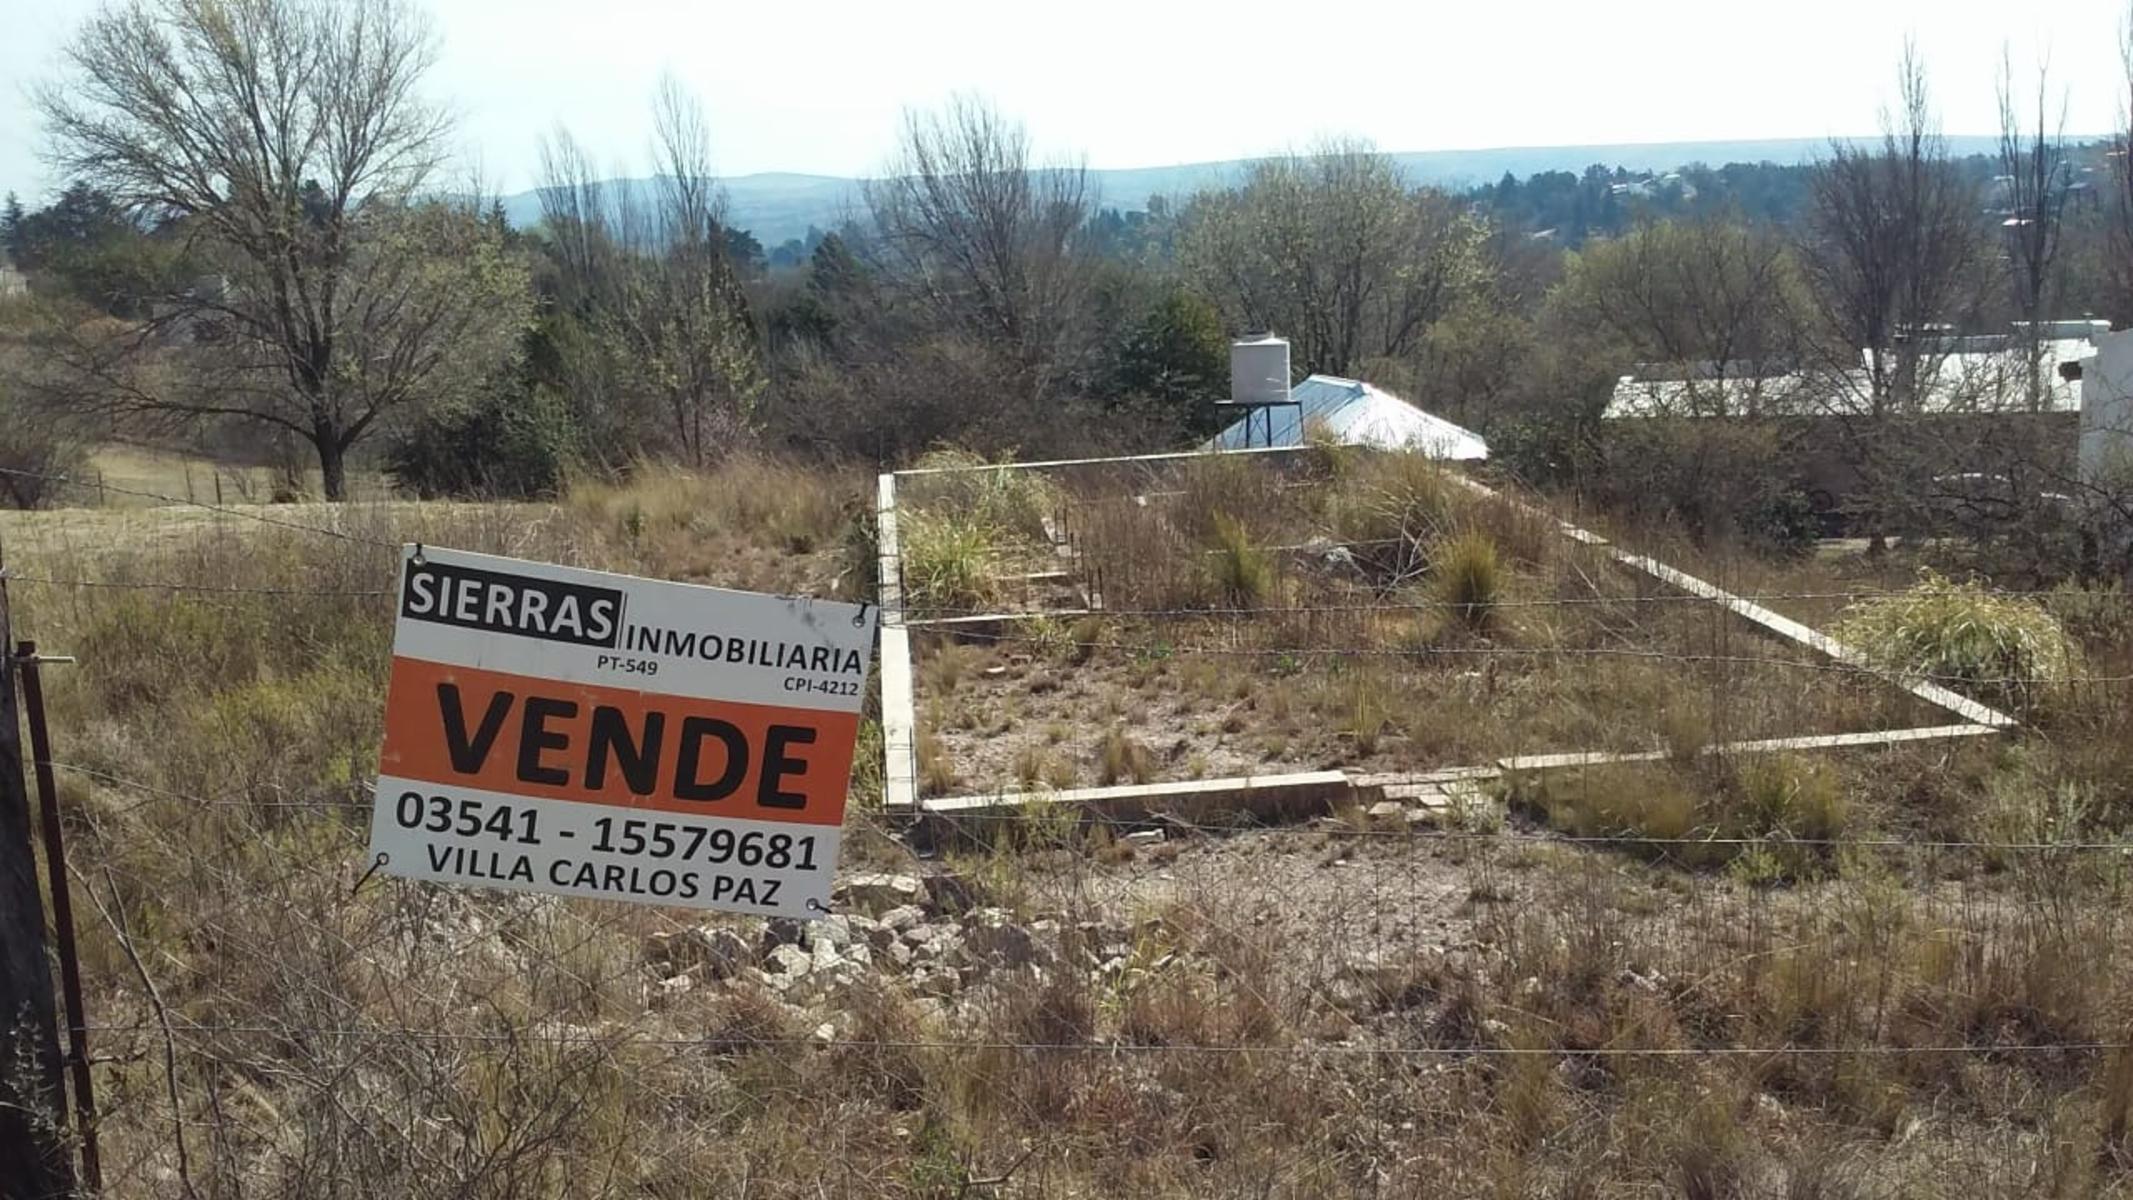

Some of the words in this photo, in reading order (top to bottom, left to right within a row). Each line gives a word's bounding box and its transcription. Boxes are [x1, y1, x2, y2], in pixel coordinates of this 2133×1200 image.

[408, 572, 615, 640] SIERRAS
[625, 624, 863, 676] INMOBILIARIA
[597, 656, 659, 676] PT-549
[783, 676, 859, 697] CPI-4212
[436, 682, 817, 810] VENDE
[396, 791, 542, 845] 03541
[591, 817, 818, 871] 15579681
[426, 844, 534, 883] VILLA
[548, 859, 699, 899] CARLOS
[712, 875, 782, 907] PAZ
